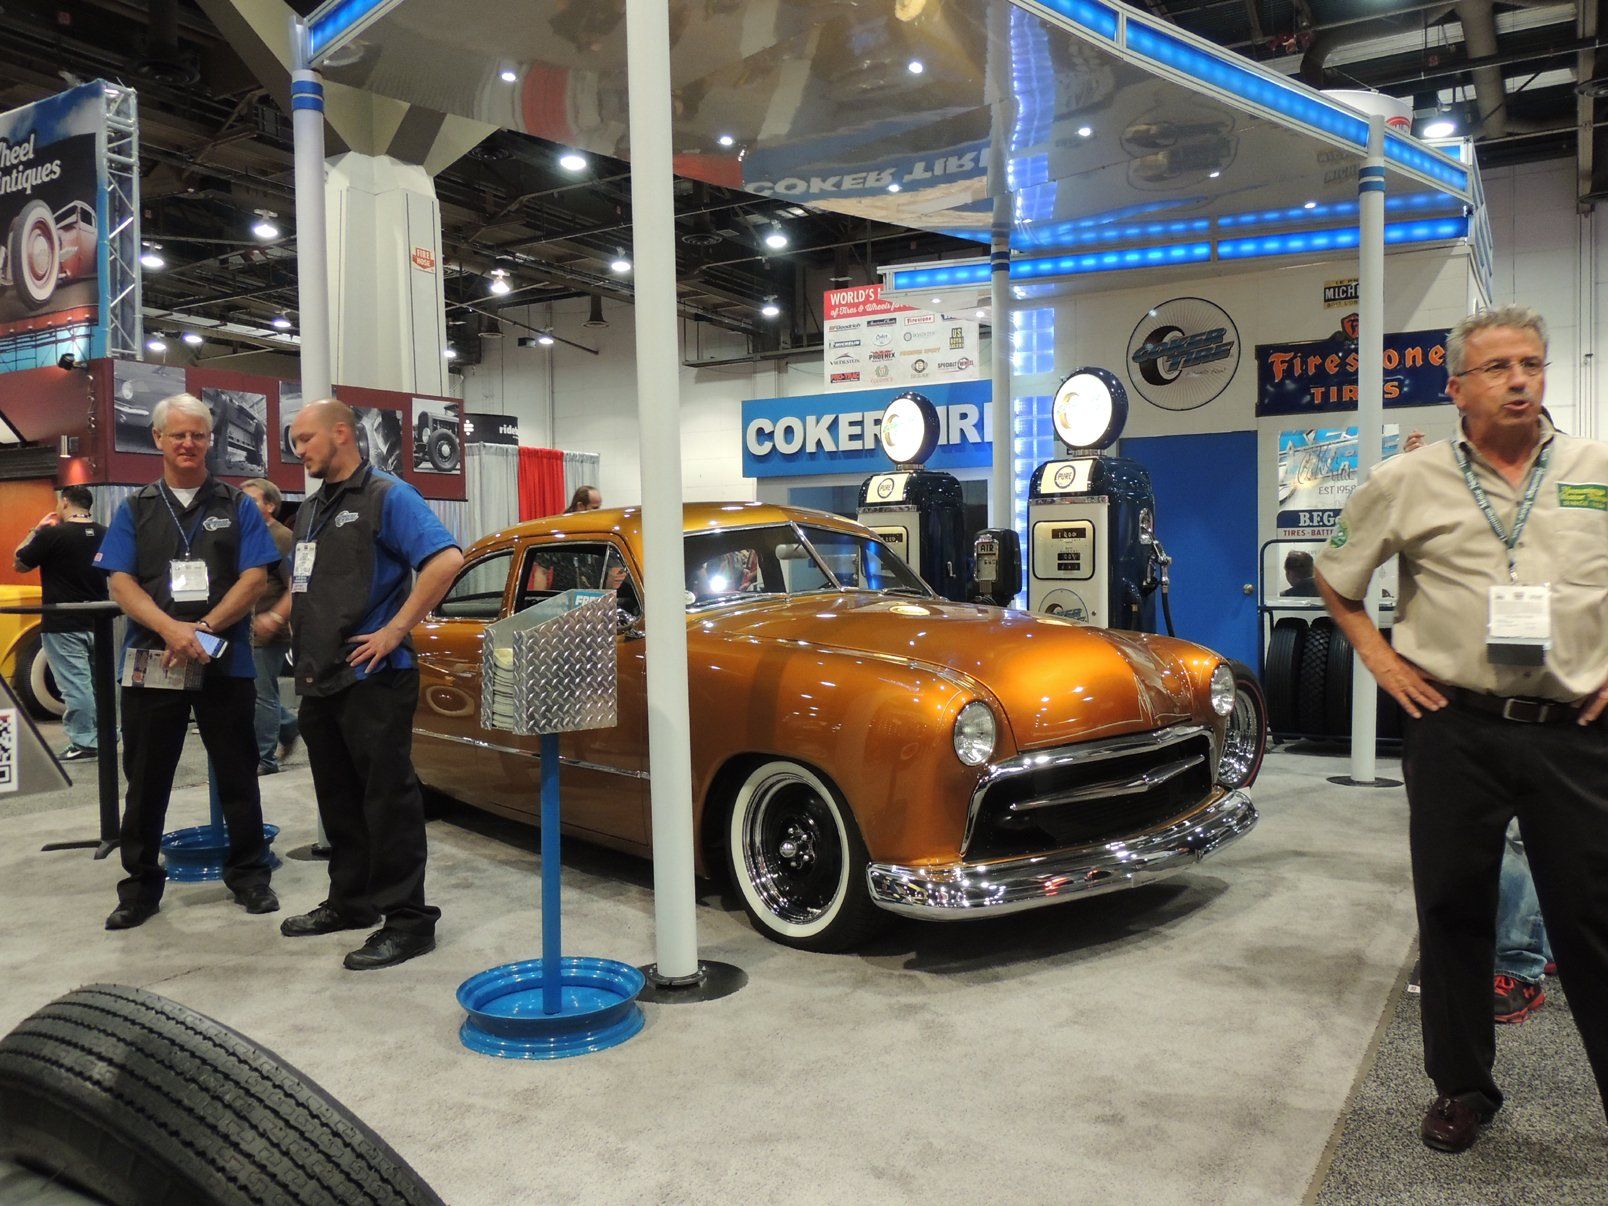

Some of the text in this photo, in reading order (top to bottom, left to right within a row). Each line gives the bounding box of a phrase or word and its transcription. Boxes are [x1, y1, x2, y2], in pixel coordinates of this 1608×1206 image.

[0, 133, 35, 168] heel
[0, 160, 62, 194] ntiques
[830, 288, 875, 305] WORLD'S
[1325, 284, 1358, 300] MICH
[1167, 341, 1234, 372] TIRE
[1268, 344, 1445, 383] Firesone
[1311, 381, 1400, 404] TIRS
[747, 402, 992, 456] COKER IR
[1318, 486, 1334, 495] EST
[980, 544, 994, 552] AIR
[575, 595, 599, 606] FR
